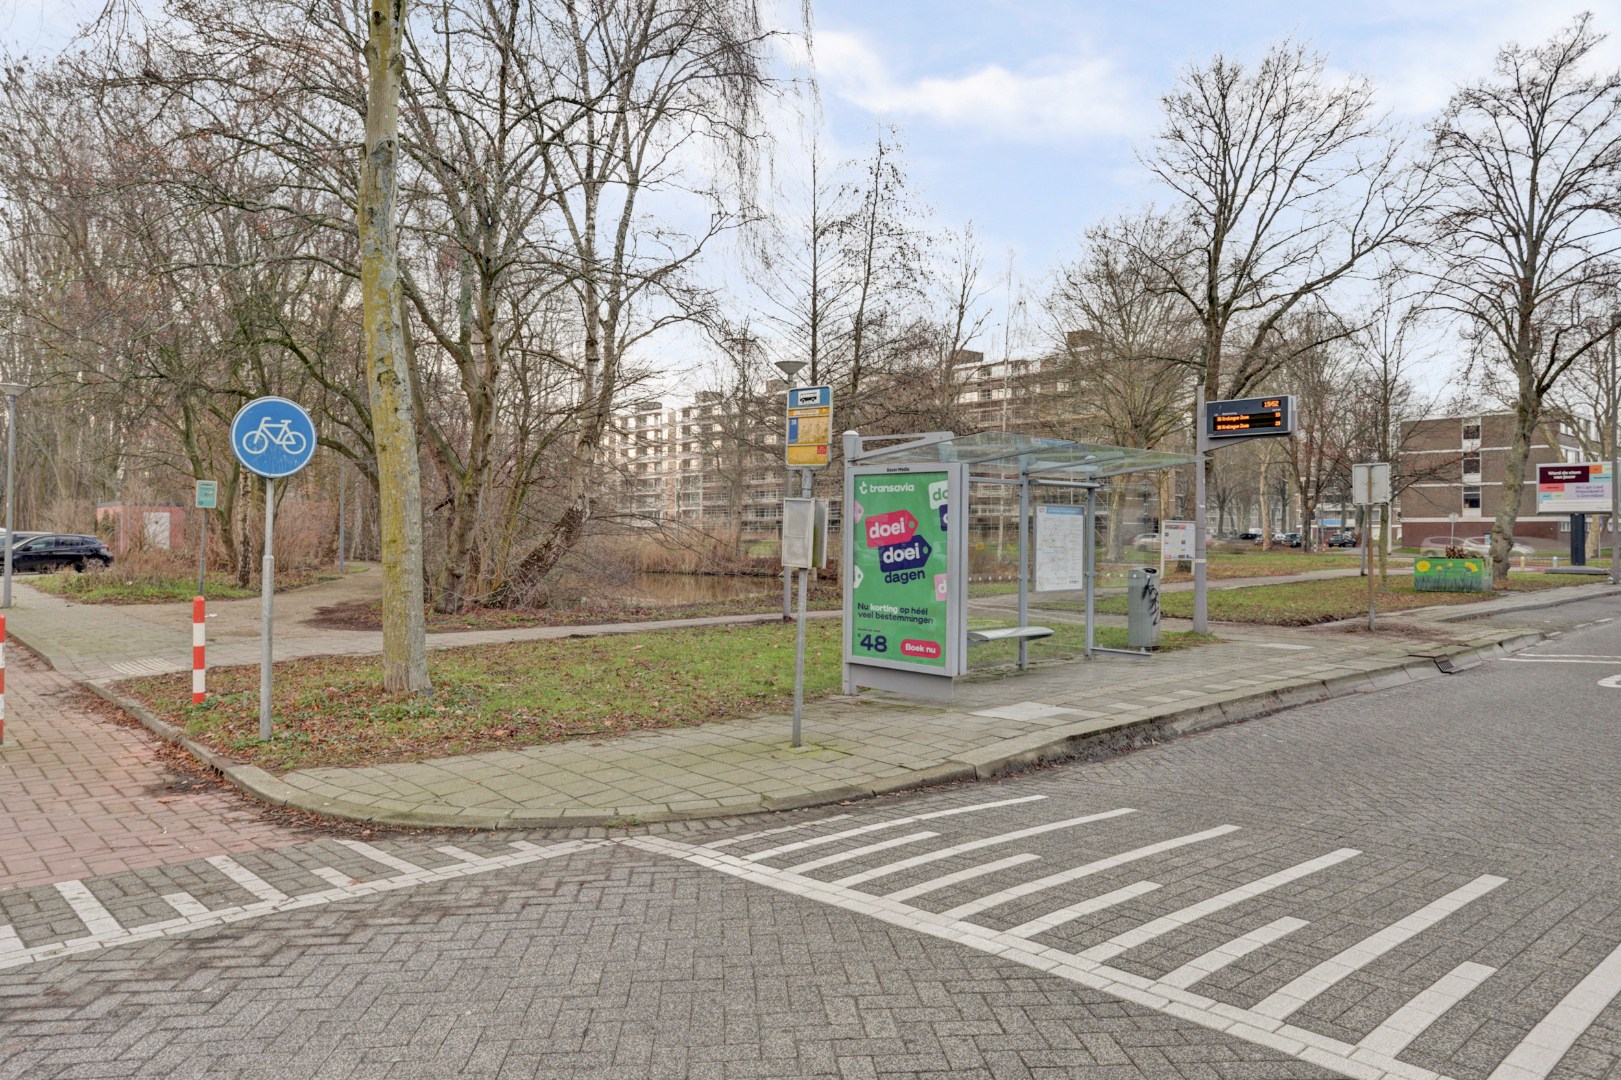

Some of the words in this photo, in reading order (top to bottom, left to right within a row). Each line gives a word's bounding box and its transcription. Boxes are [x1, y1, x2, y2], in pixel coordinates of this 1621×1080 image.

[869, 483, 915, 493] transavia
[869, 517, 906, 539] doei
[882, 542, 921, 564] doei
[884, 569, 926, 585] dagen
[857, 602, 869, 611] Nu
[870, 603, 898, 614] korting
[900, 607, 910, 615] op
[910, 606, 928, 615] héél
[858, 611, 874, 619] veel
[875, 612, 934, 625] bestemmingen
[904, 642, 925, 652] Boek
